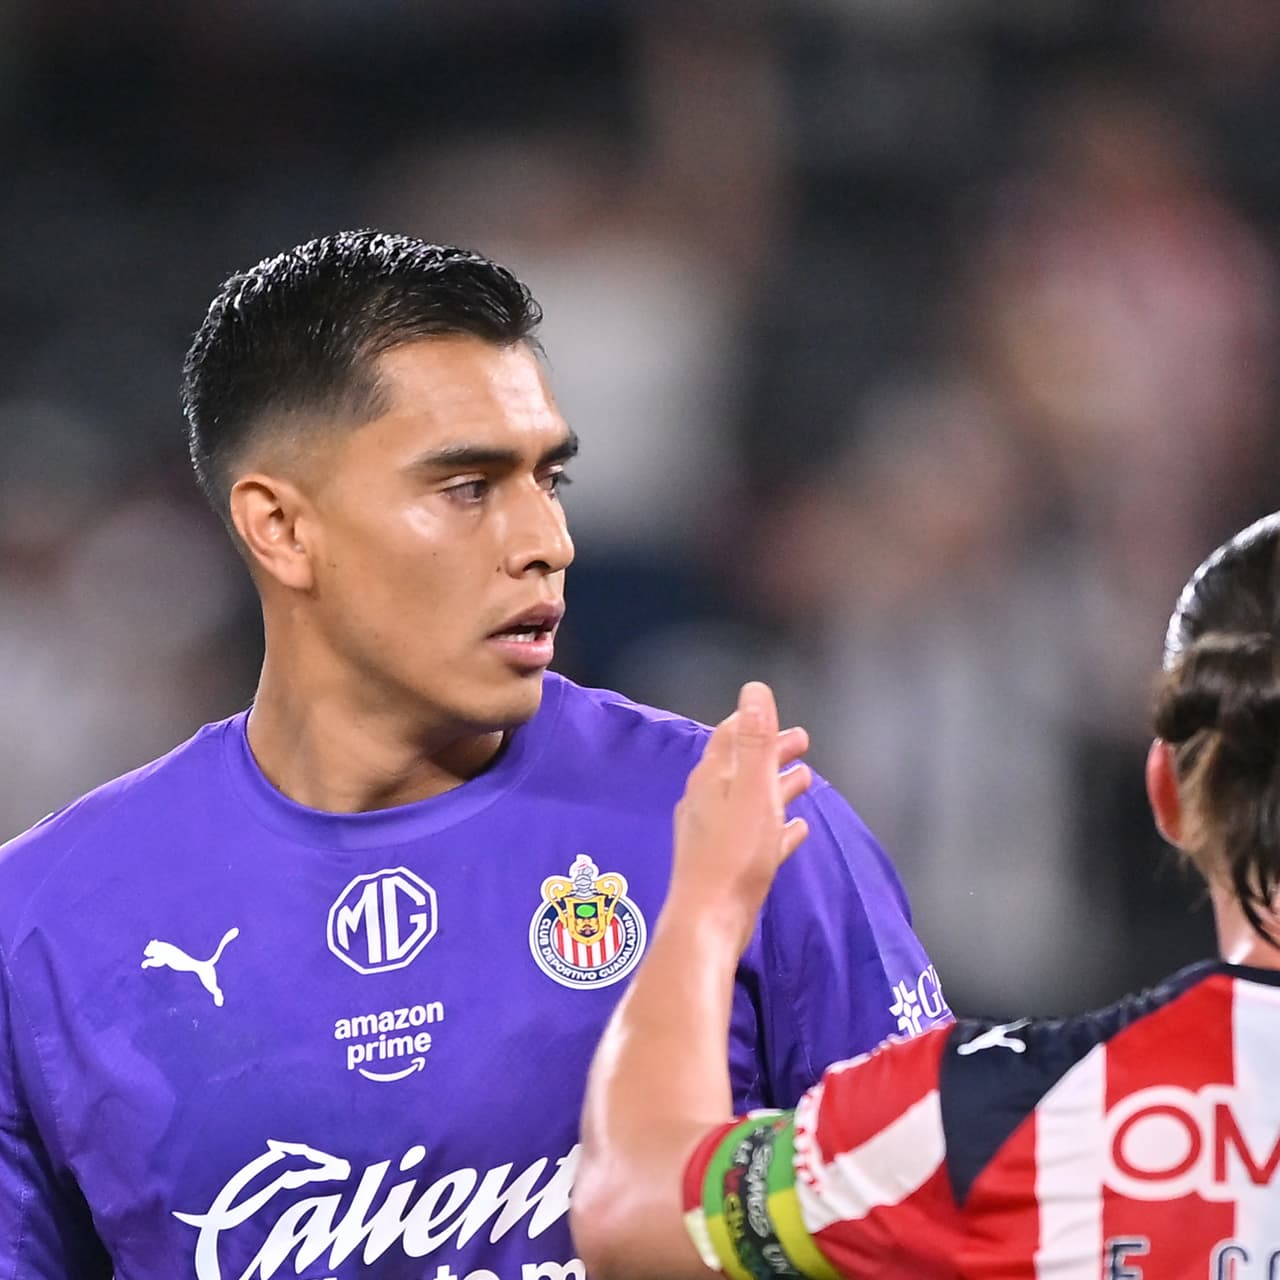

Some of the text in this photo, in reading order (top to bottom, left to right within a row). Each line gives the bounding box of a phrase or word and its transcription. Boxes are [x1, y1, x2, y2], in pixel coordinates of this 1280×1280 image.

[336, 875, 428, 964] MG
[538, 918, 551, 947] CLUB
[541, 946, 597, 981] DEPORTIVO
[334, 1001, 444, 1039] amazon
[347, 1032, 432, 1070] prime
